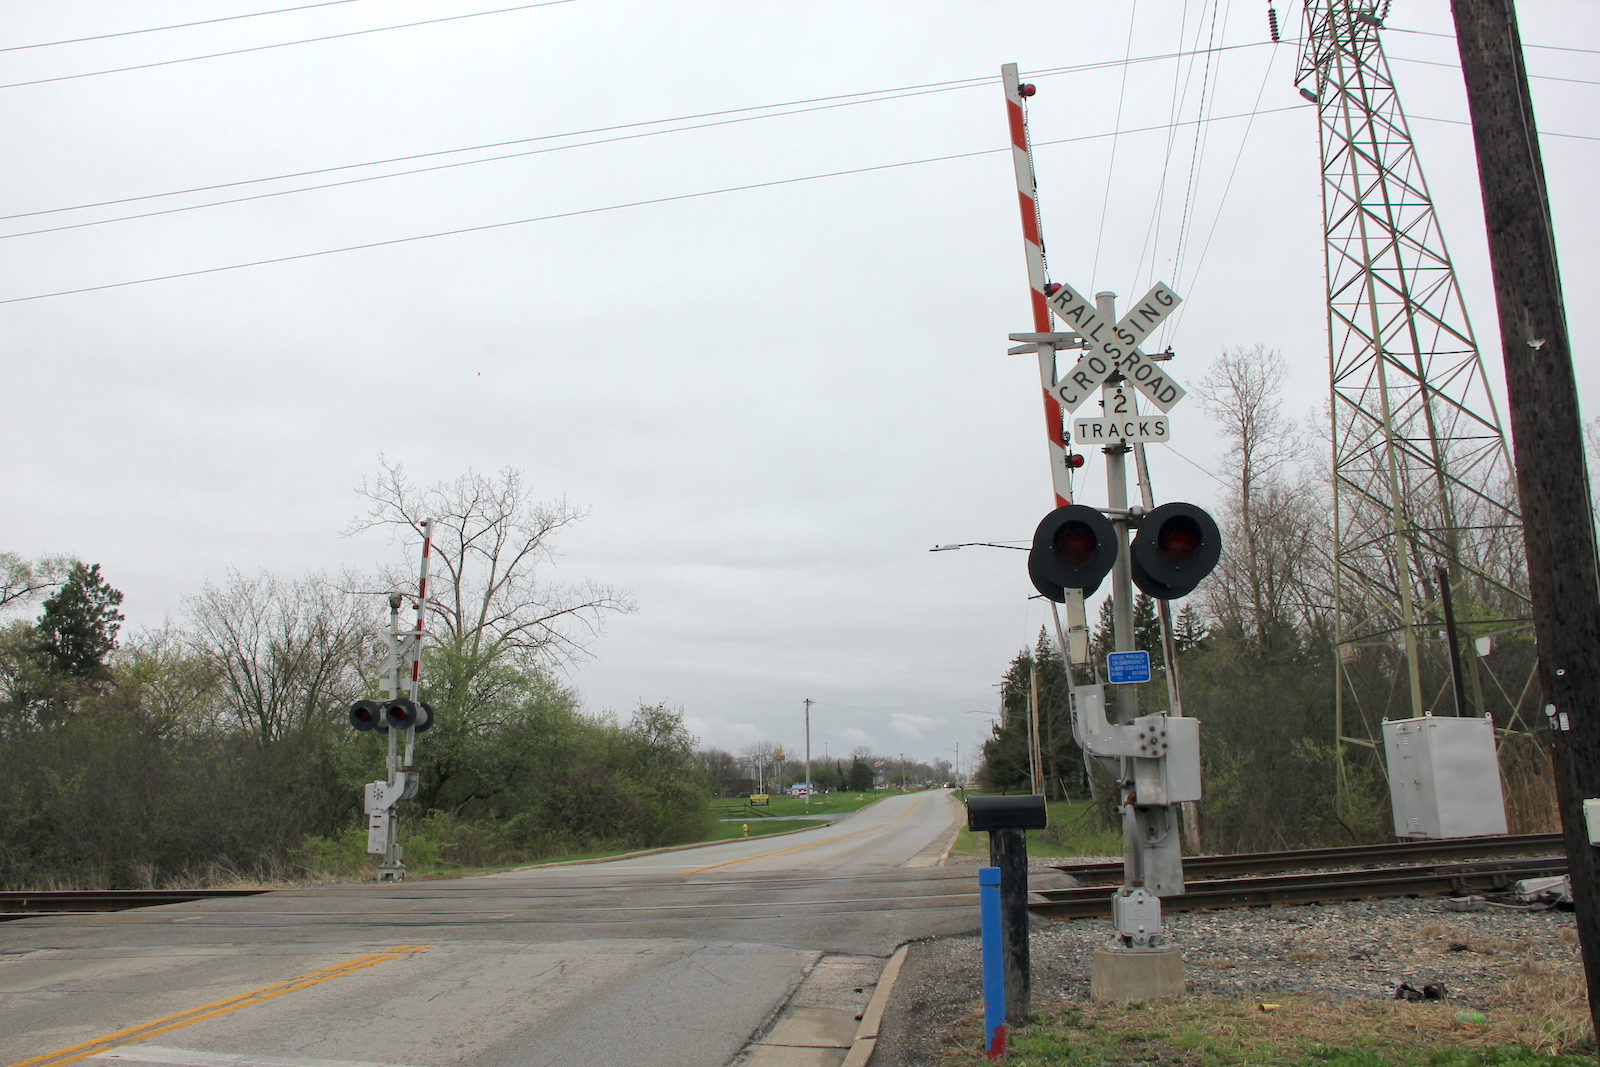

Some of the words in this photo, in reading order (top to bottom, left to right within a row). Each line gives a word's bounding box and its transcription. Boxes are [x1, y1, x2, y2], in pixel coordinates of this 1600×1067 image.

[1053, 289, 1105, 343] RAIL
[1120, 351, 1177, 404] ROAD
[1058, 289, 1174, 404] CROSSING
[1078, 421, 1165, 438] TRACKS
[1114, 394, 1128, 414] 2
